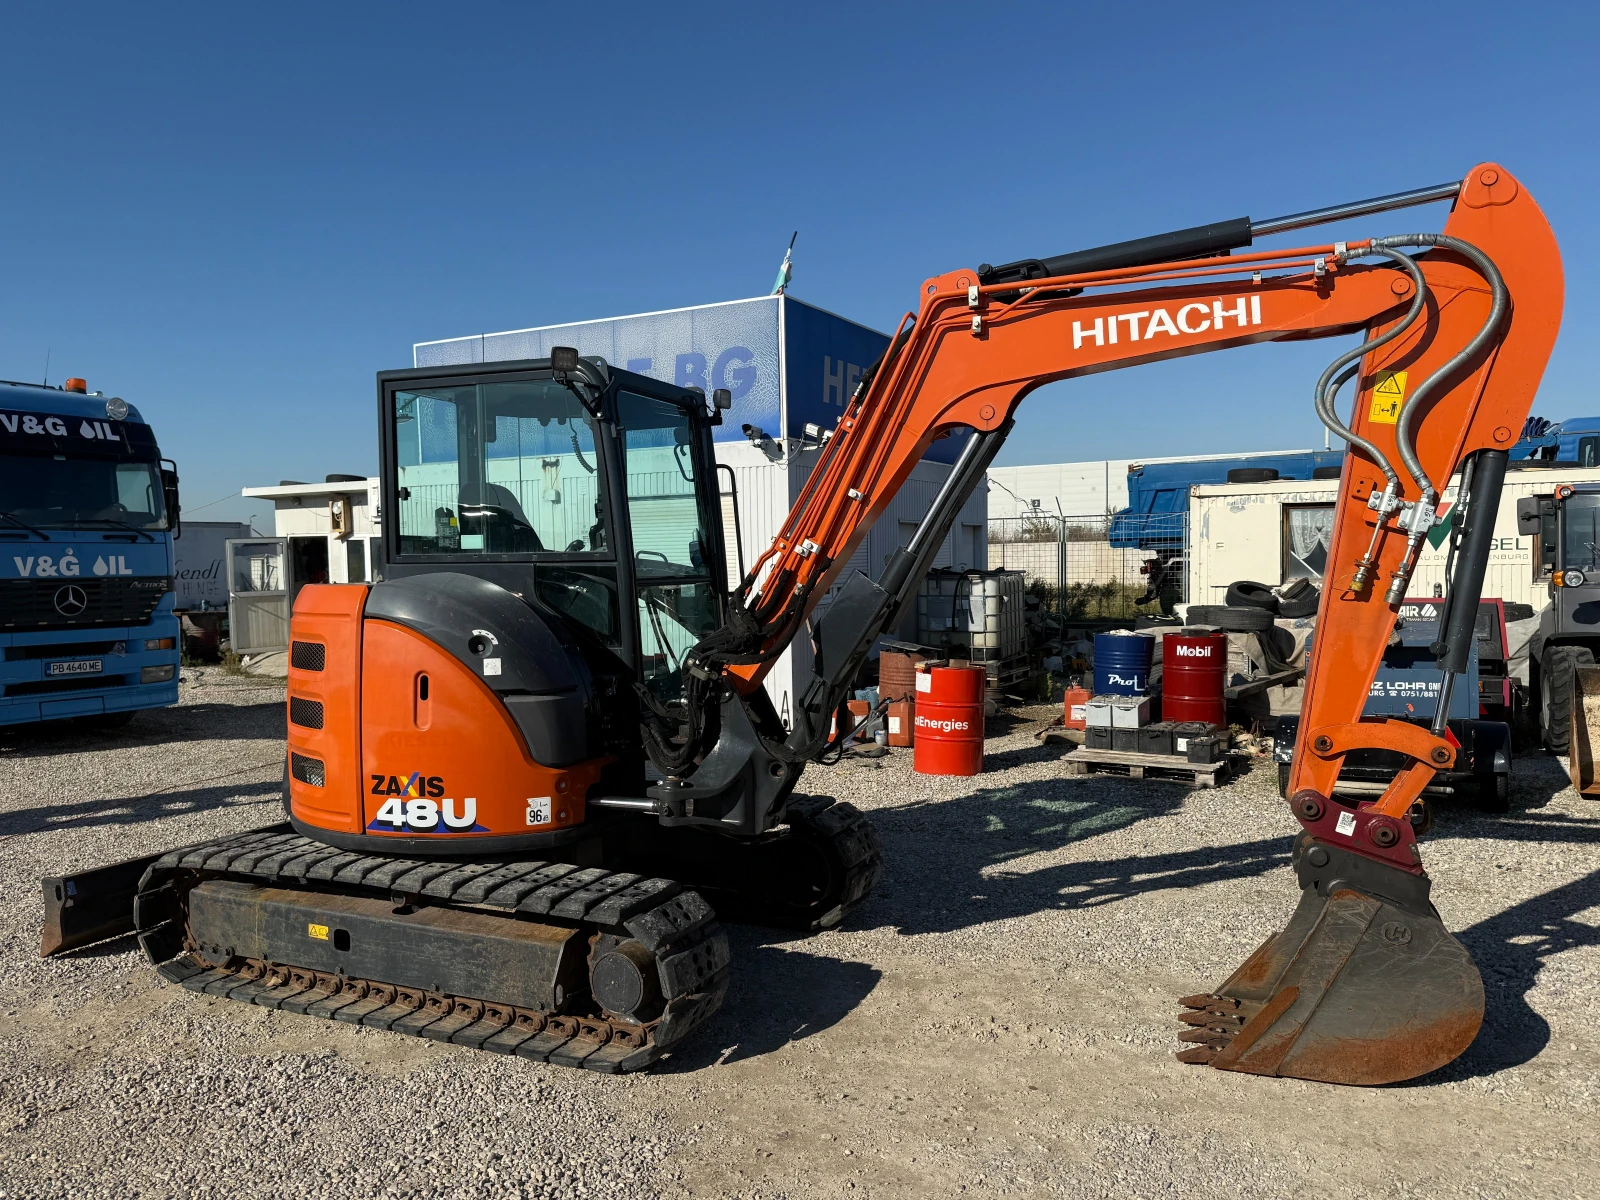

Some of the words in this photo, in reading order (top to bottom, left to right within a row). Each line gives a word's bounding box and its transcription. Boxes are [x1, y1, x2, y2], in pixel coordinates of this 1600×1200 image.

[1072, 295, 1261, 349] HITACHI
[0, 414, 68, 436] V&G
[13, 555, 80, 577] V&G
[1176, 645, 1211, 657] Mobil
[66, 662, 88, 672] 4640
[88, 661, 100, 671] ME
[1386, 681, 1426, 690] LOHR
[371, 772, 445, 798] ZAXIS
[376, 797, 477, 834] 48U
[529, 809, 543, 823] 96
